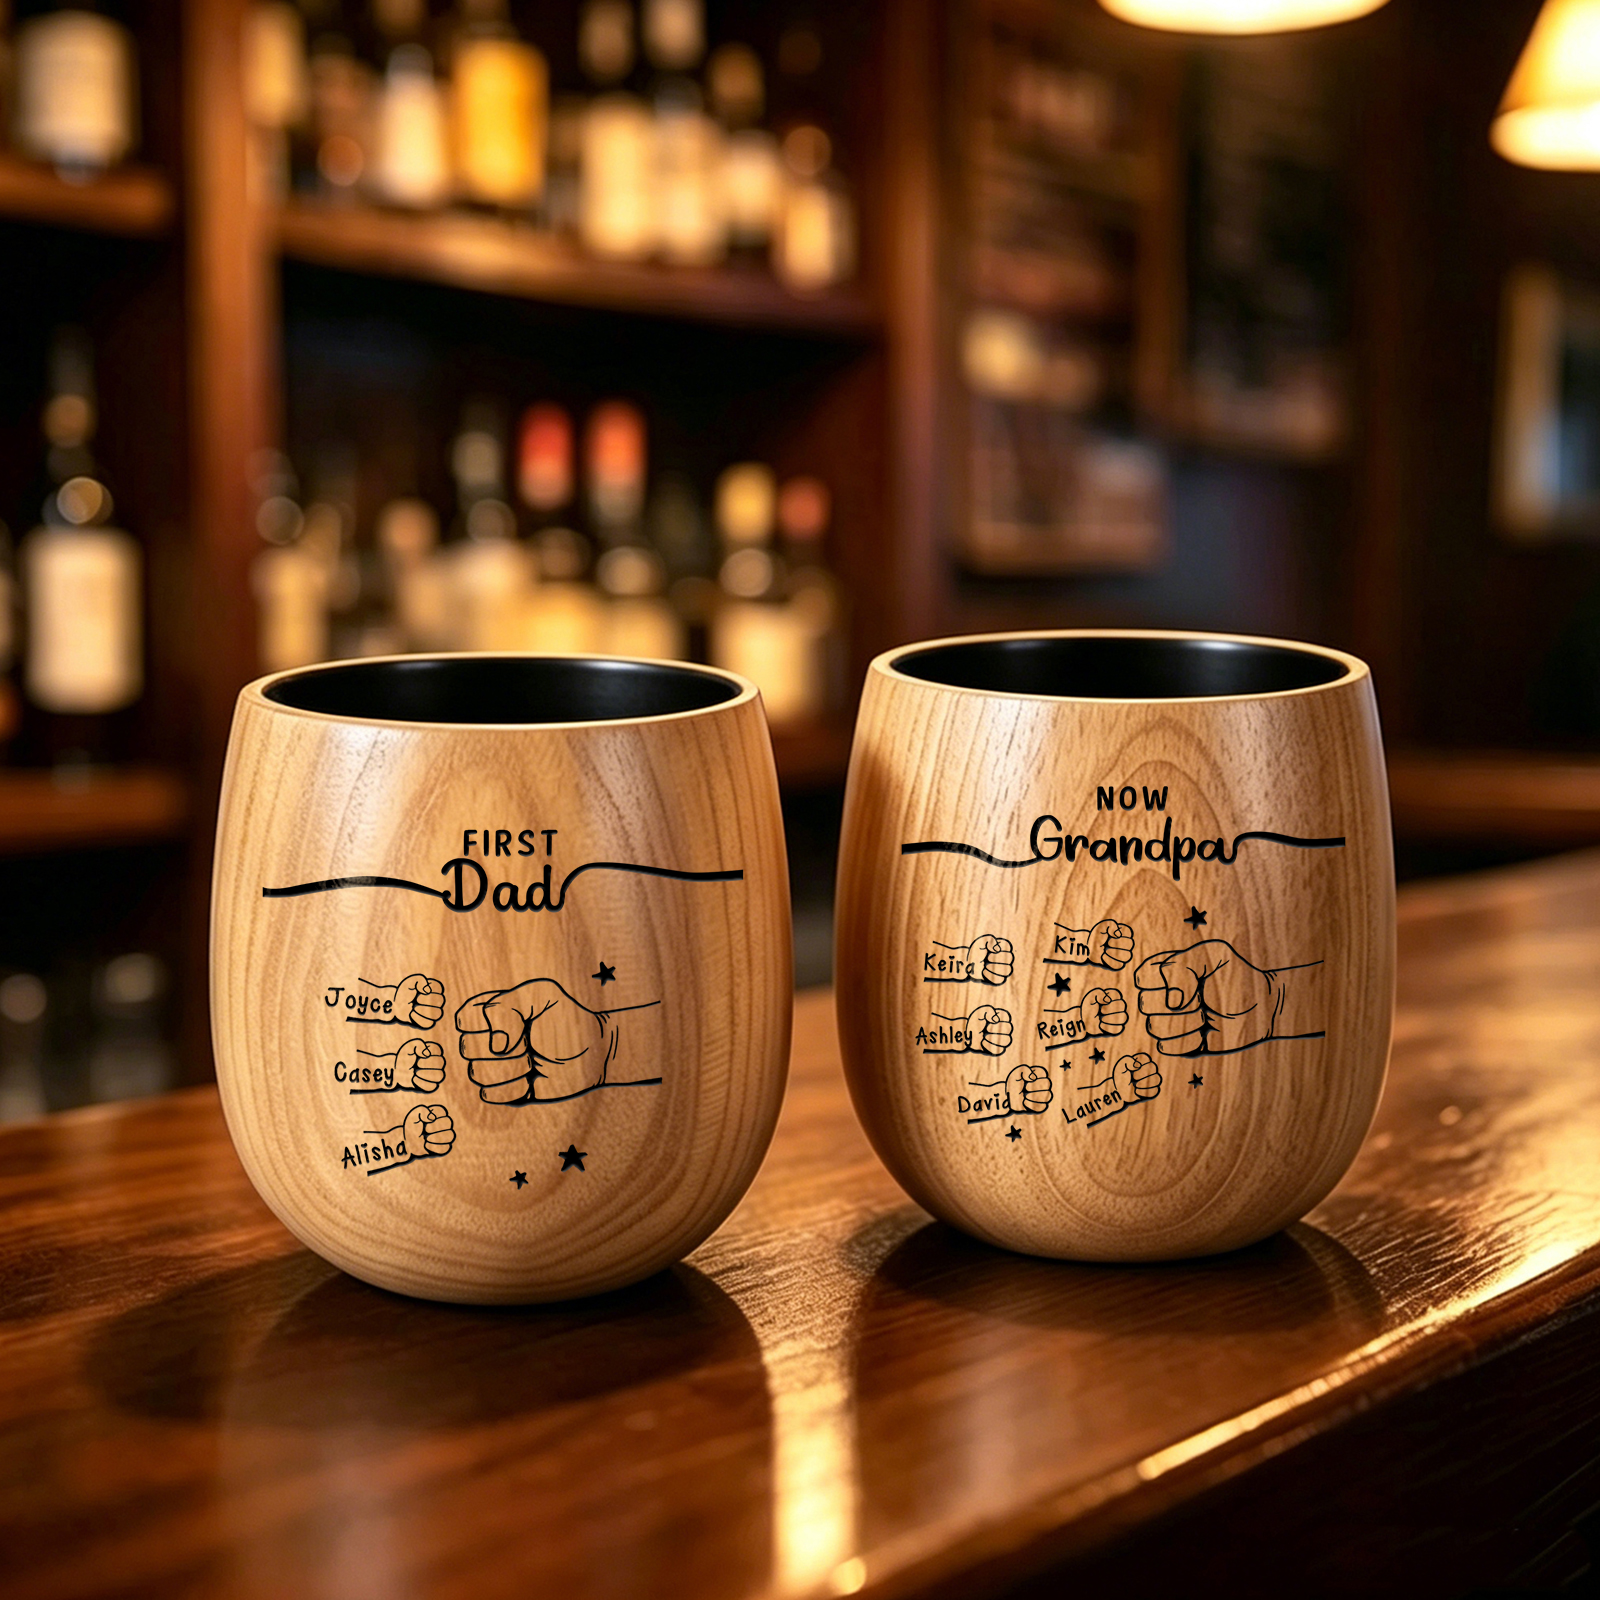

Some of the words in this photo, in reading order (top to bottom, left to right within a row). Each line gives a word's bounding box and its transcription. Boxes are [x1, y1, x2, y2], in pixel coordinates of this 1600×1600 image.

[1096, 785, 1169, 811] NOW
[463, 829, 558, 857] FIRST
[1029, 814, 1238, 882] Grandpa
[440, 857, 566, 913] Dad
[1054, 935, 1090, 957] Kim
[923, 952, 975, 975] Keira
[324, 987, 393, 1015] Joyce
[915, 1026, 972, 1047] Ashley
[1037, 1018, 1087, 1040] Reign
[334, 1061, 395, 1087] Casey
[957, 1092, 1012, 1114] David
[1061, 1089, 1122, 1124] Lauren
[341, 1138, 408, 1170] Alisha
